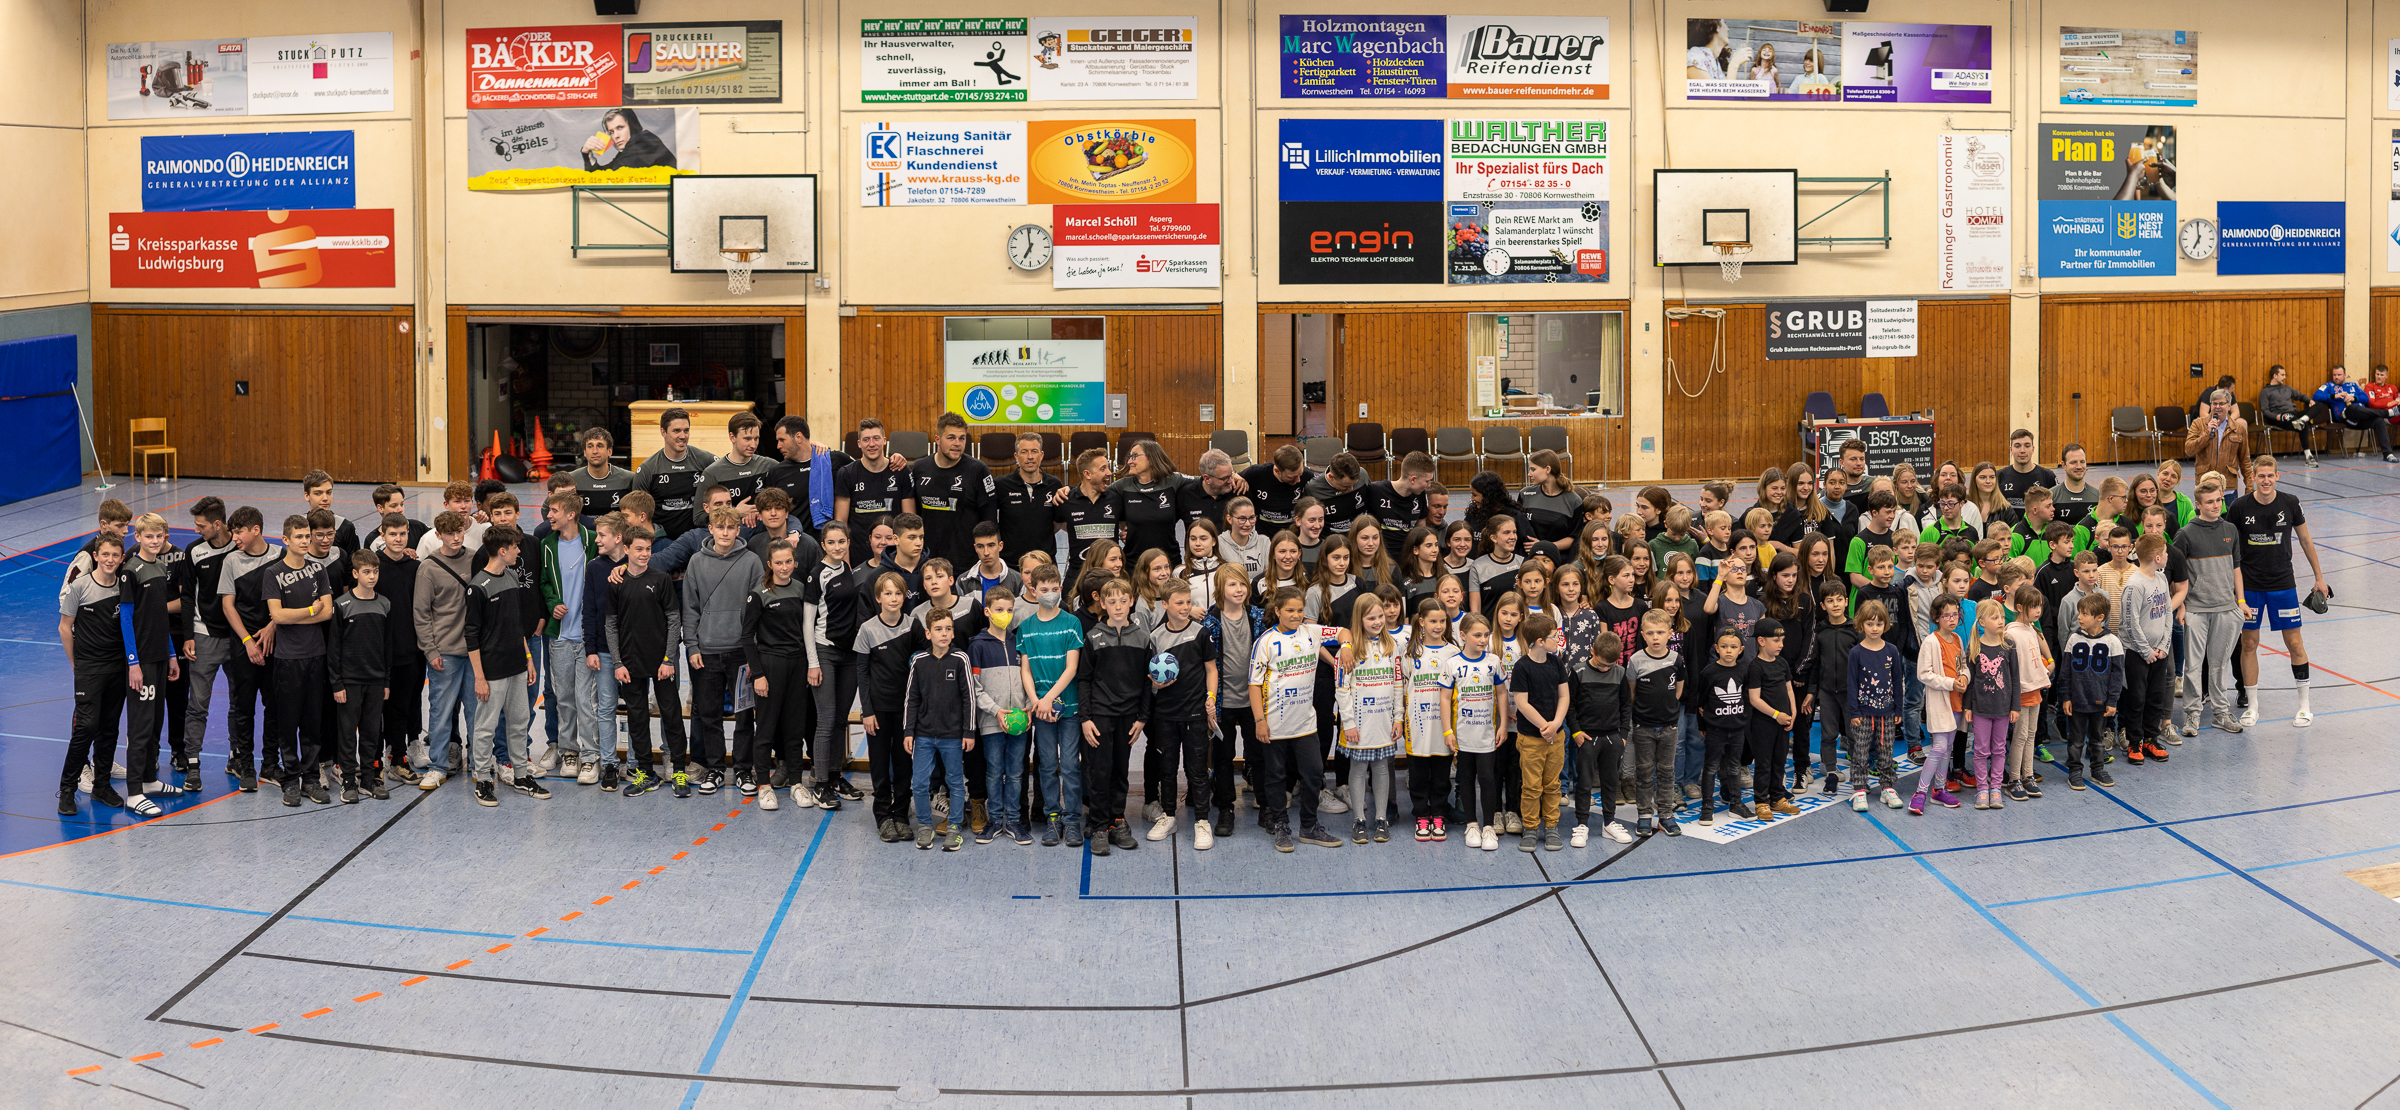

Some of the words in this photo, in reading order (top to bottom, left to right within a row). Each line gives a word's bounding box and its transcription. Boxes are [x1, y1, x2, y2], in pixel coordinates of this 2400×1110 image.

[864, 21, 882, 31] HEV
[884, 20, 902, 30] HEV
[904, 20, 922, 30] HEV
[924, 20, 942, 30] HEV
[1302, 19, 1425, 36] Holzmontagen
[530, 32, 551, 41] DER
[655, 33, 713, 41] DRUCKEREI
[1090, 28, 1181, 42] GEIGER
[864, 40, 877, 48] Ihr
[880, 40, 954, 48] Hausverwalter,
[1134, 43, 1189, 52] Malergeschäft
[1283, 35, 1332, 54] Marc
[1334, 32, 1444, 58] Wagenbach
[278, 49, 309, 60] STUCK
[1299, 57, 1334, 66] Küchen
[1372, 57, 1424, 66] Holzdecken
[887, 67, 945, 75] zuverlässig,
[1299, 67, 1356, 78] Fertigparkett
[1372, 67, 1418, 76] Haustüren
[1467, 62, 1592, 76] Reifendienst
[1299, 77, 1335, 85] Laminat
[1372, 76, 1437, 85] Fenster+Türen
[1954, 72, 1984, 80] ADASYS
[478, 74, 589, 89] Dannenmann
[899, 79, 930, 87] immer
[951, 79, 970, 87] Ball
[313, 88, 389, 97] www.stuckputz-kornwestheim.de
[656, 86, 685, 94] Telefon
[687, 85, 742, 94] 07154/5182
[1301, 87, 1353, 95] Kornwestheim
[1463, 86, 1594, 96] www.bauer-reifenundmehr.de
[864, 92, 948, 102] www.hev-stuttgart.de
[1451, 120, 1606, 142] WALTHER
[907, 131, 959, 143] Heizung
[964, 131, 1011, 141] Sanitär
[1064, 129, 1156, 146] Obstkörble
[511, 136, 548, 154] spiels
[1451, 143, 1560, 153] BEDACHUNGEN
[1565, 143, 1606, 153] GMBH
[2052, 138, 2096, 161] Plan
[2101, 138, 2114, 161] B
[907, 146, 983, 155] Flaschnerei
[1315, 149, 1441, 164] LillichImmobilien
[147, 159, 224, 174] RAIMONDO
[251, 155, 348, 172] HEIDENREICH
[907, 160, 997, 170] Kundendienst
[1456, 162, 1473, 174] Ihr
[1477, 161, 1538, 177] Spezialist
[1543, 161, 1567, 174] fürs
[1572, 162, 1603, 174] Dach
[1315, 168, 1345, 176] VERKAUF
[1350, 168, 1392, 176] VERMIETUNG
[1396, 168, 1440, 176] VERWALTUNG
[1942, 136, 1952, 218] Gastronomie
[147, 178, 268, 189] GENERALVERTRETUNG
[275, 178, 295, 186] DER
[301, 177, 349, 185] ALLIANZ
[514, 176, 585, 185] Respektlosigkeit
[907, 174, 1020, 185] www.krauss-kg.de
[907, 187, 937, 195] Telefon
[1965, 206, 2003, 215] HOTEL
[1065, 216, 1101, 226] Marcel
[1103, 216, 1137, 226] Schöll
[1149, 215, 1172, 223] Asperg
[1495, 216, 1511, 224] Dein
[1513, 216, 1535, 224] REWE
[1538, 216, 1559, 224] Markt
[1966, 216, 2003, 224] DOMIZIL
[2138, 212, 2163, 221] KORN
[2052, 224, 2104, 234] WOHNBAU
[2138, 221, 2162, 230] WEST
[1495, 227, 1555, 236] Salamanderplatz
[2222, 228, 2268, 238] RAIMONDO
[2285, 228, 2340, 238] HEIDENREICH
[1065, 233, 1207, 241] marcel.schoell@sparkassenversicherung.de
[1310, 222, 1413, 253] engin
[1508, 237, 1559, 245] beerenstarkes
[1561, 237, 1582, 246] Spiel!
[138, 237, 238, 253] Kreissparkasse
[332, 238, 382, 247] www.ksklb.de
[1942, 223, 1956, 288] Renninger
[2074, 248, 2087, 257] Ihr
[2089, 248, 2142, 257] kommunaler
[138, 256, 224, 272] Ludwigsburg
[2060, 260, 2091, 269] Partner
[2094, 260, 2106, 268] für
[2107, 259, 2155, 268] Immobilien
[1165, 266, 1207, 274] Versicherung
[1786, 309, 1863, 330] GRUB
[1868, 430, 1899, 446] BST
[1900, 435, 1932, 446] Cargo
[658, 474, 669, 483] 20
[920, 476, 931, 485] 77
[854, 482, 864, 491] 18
[2004, 483, 2013, 491] 12
[729, 487, 740, 497] 30
[1257, 489, 1268, 500] 29
[1380, 498, 1391, 509] 21
[1325, 504, 1336, 515] 15
[2060, 509, 2070, 517] 17
[2245, 516, 2255, 524] 24
[275, 562, 322, 589] Kempa
[1273, 641, 1281, 656] 7
[2071, 642, 2109, 674] 98
[1457, 665, 1468, 678] 17
[139, 684, 155, 700] 99
[1461, 684, 1492, 692] WALTHER
[1715, 704, 1744, 716] adida
